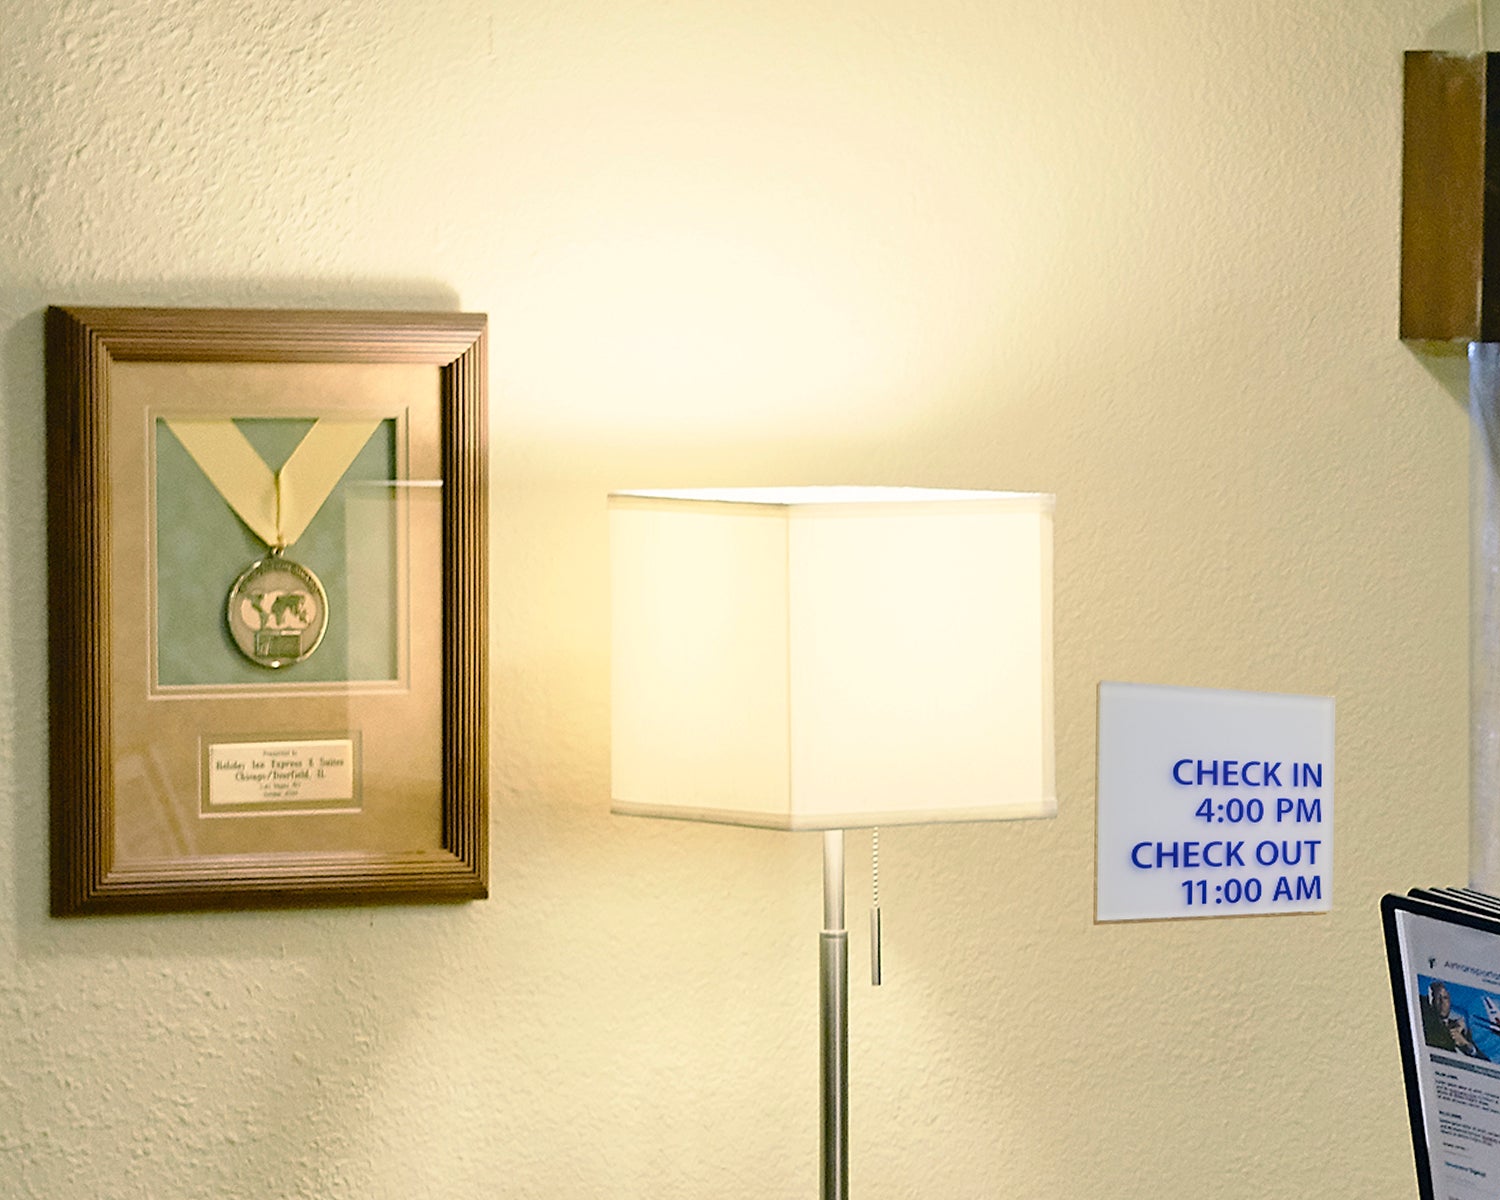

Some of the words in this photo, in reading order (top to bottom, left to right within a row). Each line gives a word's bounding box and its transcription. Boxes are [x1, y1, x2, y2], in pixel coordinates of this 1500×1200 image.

[216, 760, 245, 771] Holiday
[271, 759, 302, 770] Express
[319, 757, 344, 767] Suites
[1172, 759, 1282, 787] CHECK
[1293, 763, 1322, 788] IN
[1195, 798, 1264, 823] 4:00
[1276, 798, 1322, 823] PM
[1131, 841, 1245, 869] CHECK
[1255, 840, 1322, 866] OUT
[1181, 878, 1262, 905] 11:00
[1272, 875, 1322, 901] AM
